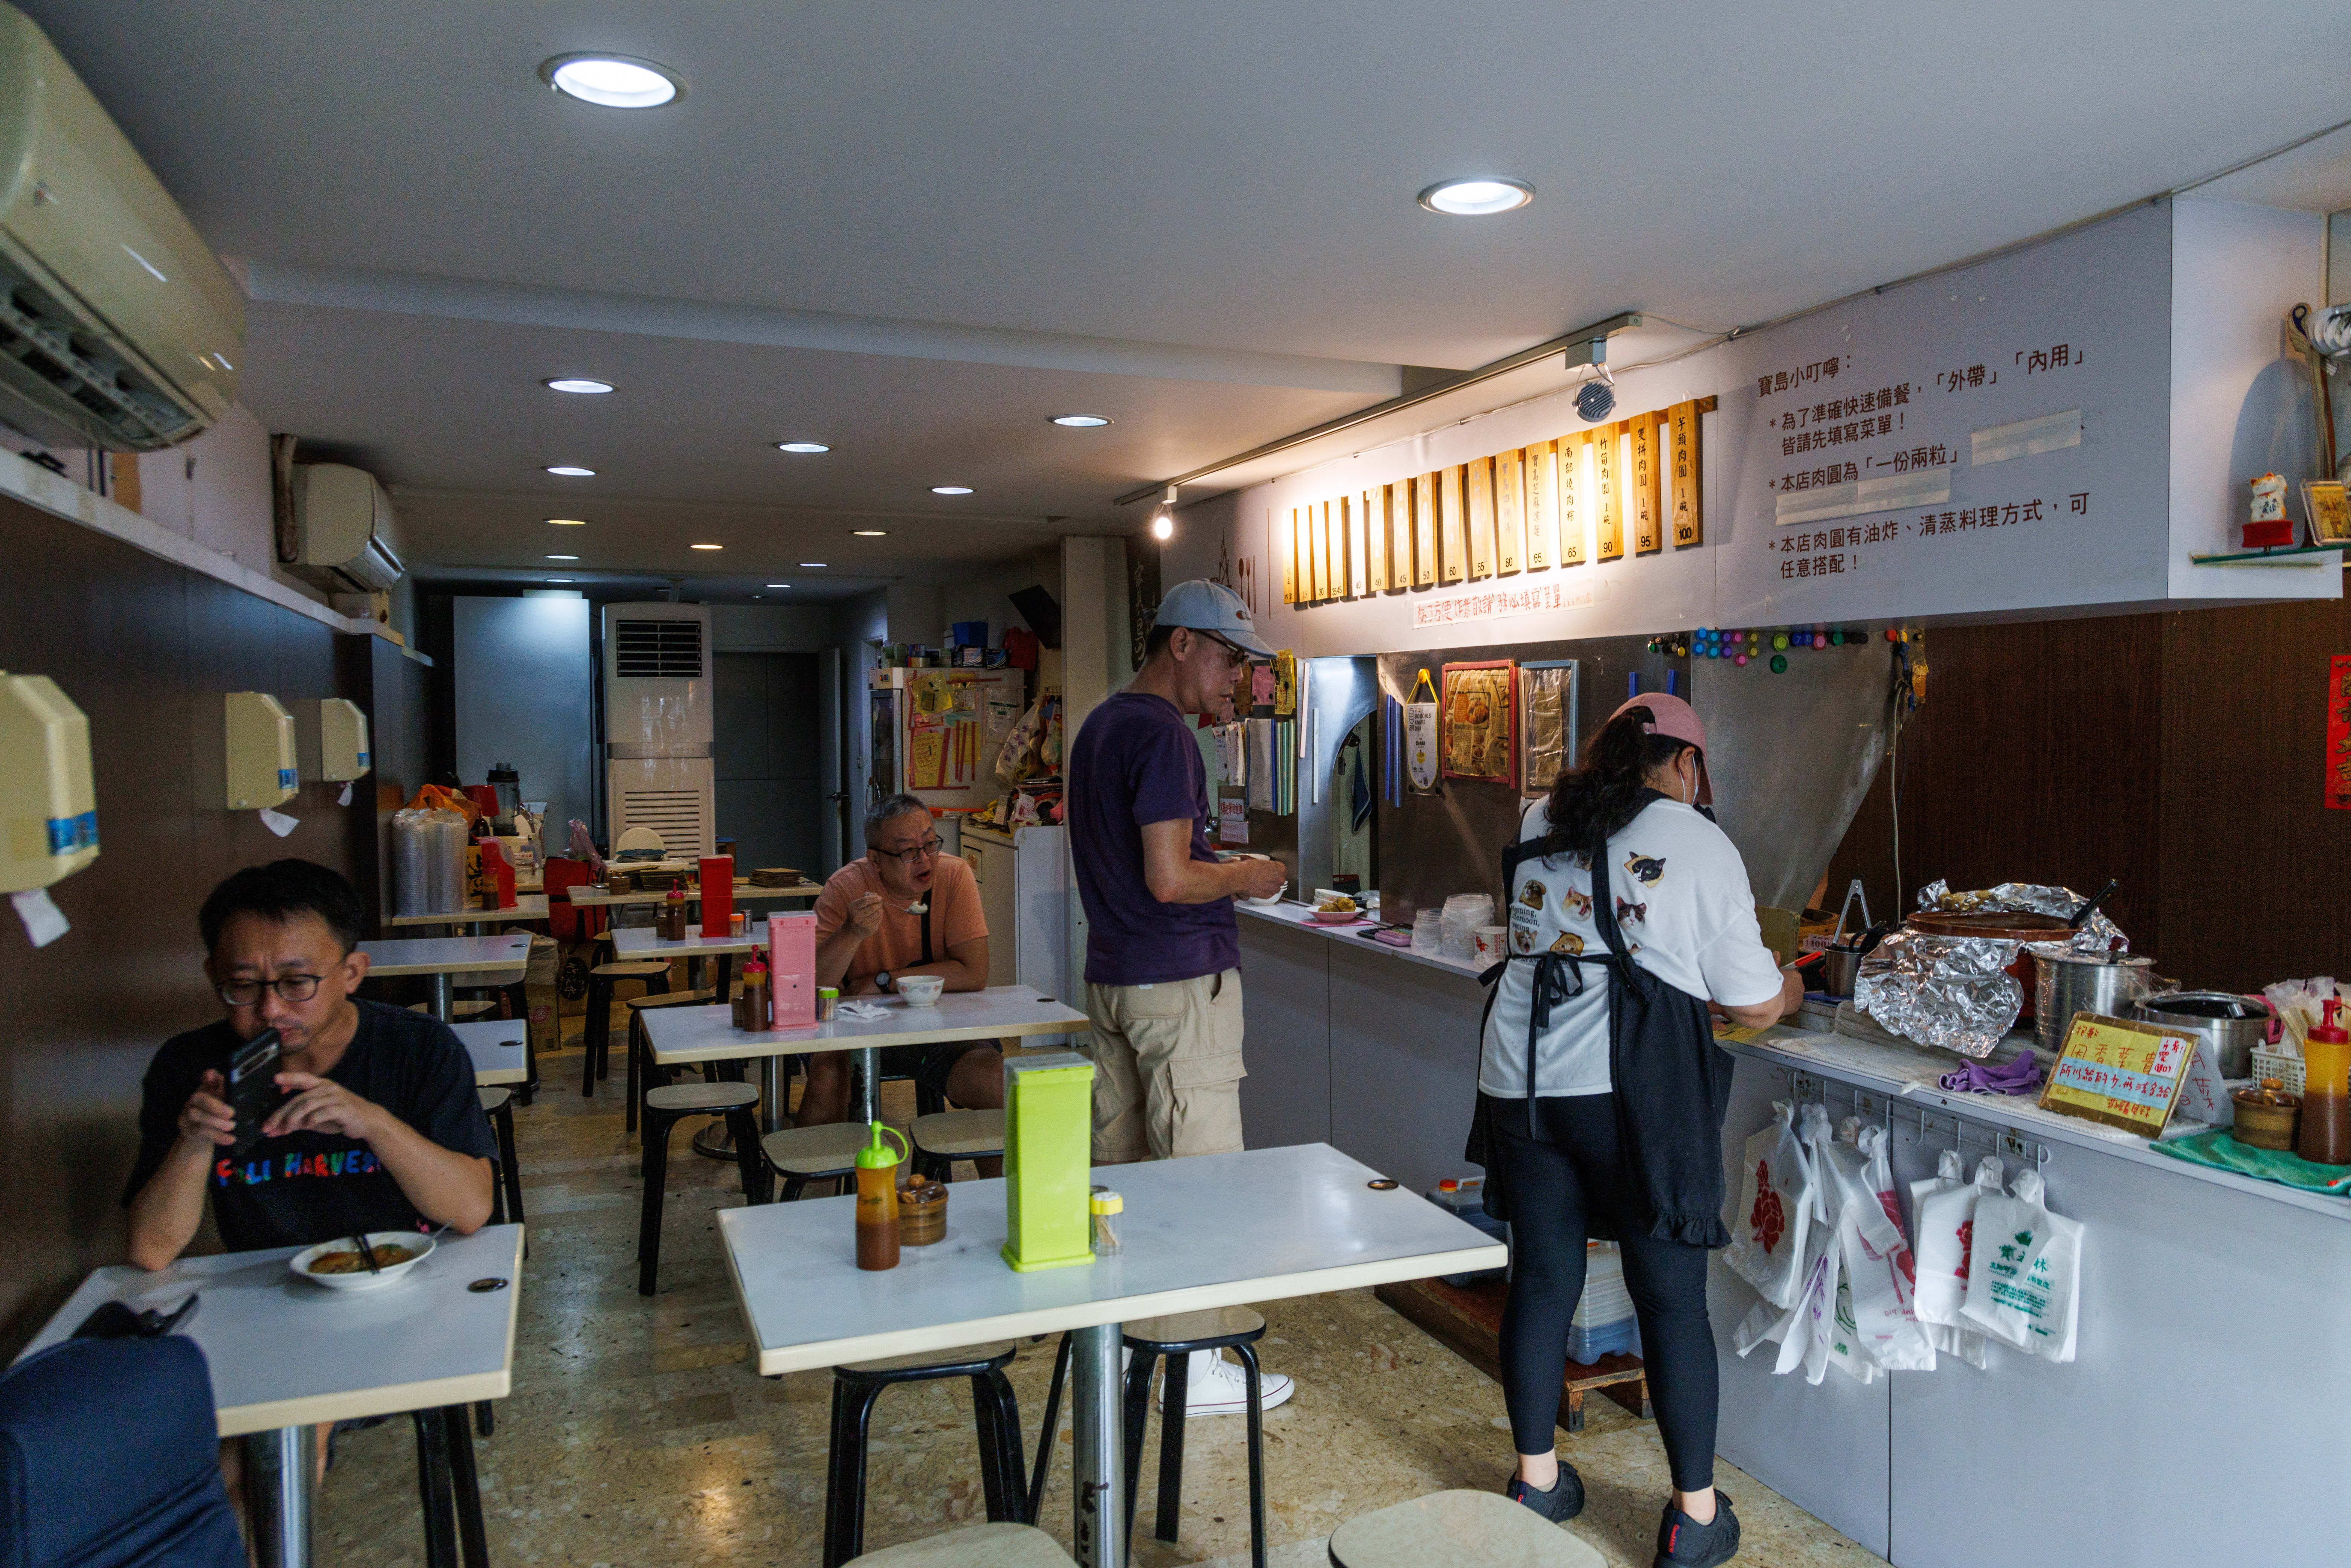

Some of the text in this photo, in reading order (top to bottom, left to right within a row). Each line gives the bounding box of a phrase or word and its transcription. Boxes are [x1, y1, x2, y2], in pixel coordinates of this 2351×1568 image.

[1758, 354, 1851, 398] 寶島小叮嚀：
[1782, 413, 1904, 456] 皆請先填寫菜單！
[1678, 416, 1687, 477] 芋頭肉圓
[1638, 427, 1647, 486] 雙拼肉圓
[1600, 438, 1609, 494] 竹筍肉圓
[1781, 443, 1958, 492] 本店肉圓為「一份兩粒」
[1565, 447, 1574, 522] 南部燒肉粽
[1678, 527, 1692, 540] 100
[1603, 541, 1612, 553] 90
[1641, 535, 1650, 547] 95
[1534, 552, 1542, 563] 65
[1568, 547, 1576, 558] 65
[1478, 562, 1484, 572] 55
[1506, 557, 1512, 567] 80
[1780, 555, 1857, 579] 任意搭配！
[1423, 571, 1430, 580] 50
[1449, 566, 1456, 576] 60
[1375, 578, 1381, 587] 40
[1400, 574, 1406, 583] 45
[1337, 586, 1342, 594] 45
[1356, 581, 1361, 589] 40
[1319, 587, 1324, 596] 30
[2076, 1025, 2099, 1039] 抱歉
[284, 1150, 380, 1178] HARVES
